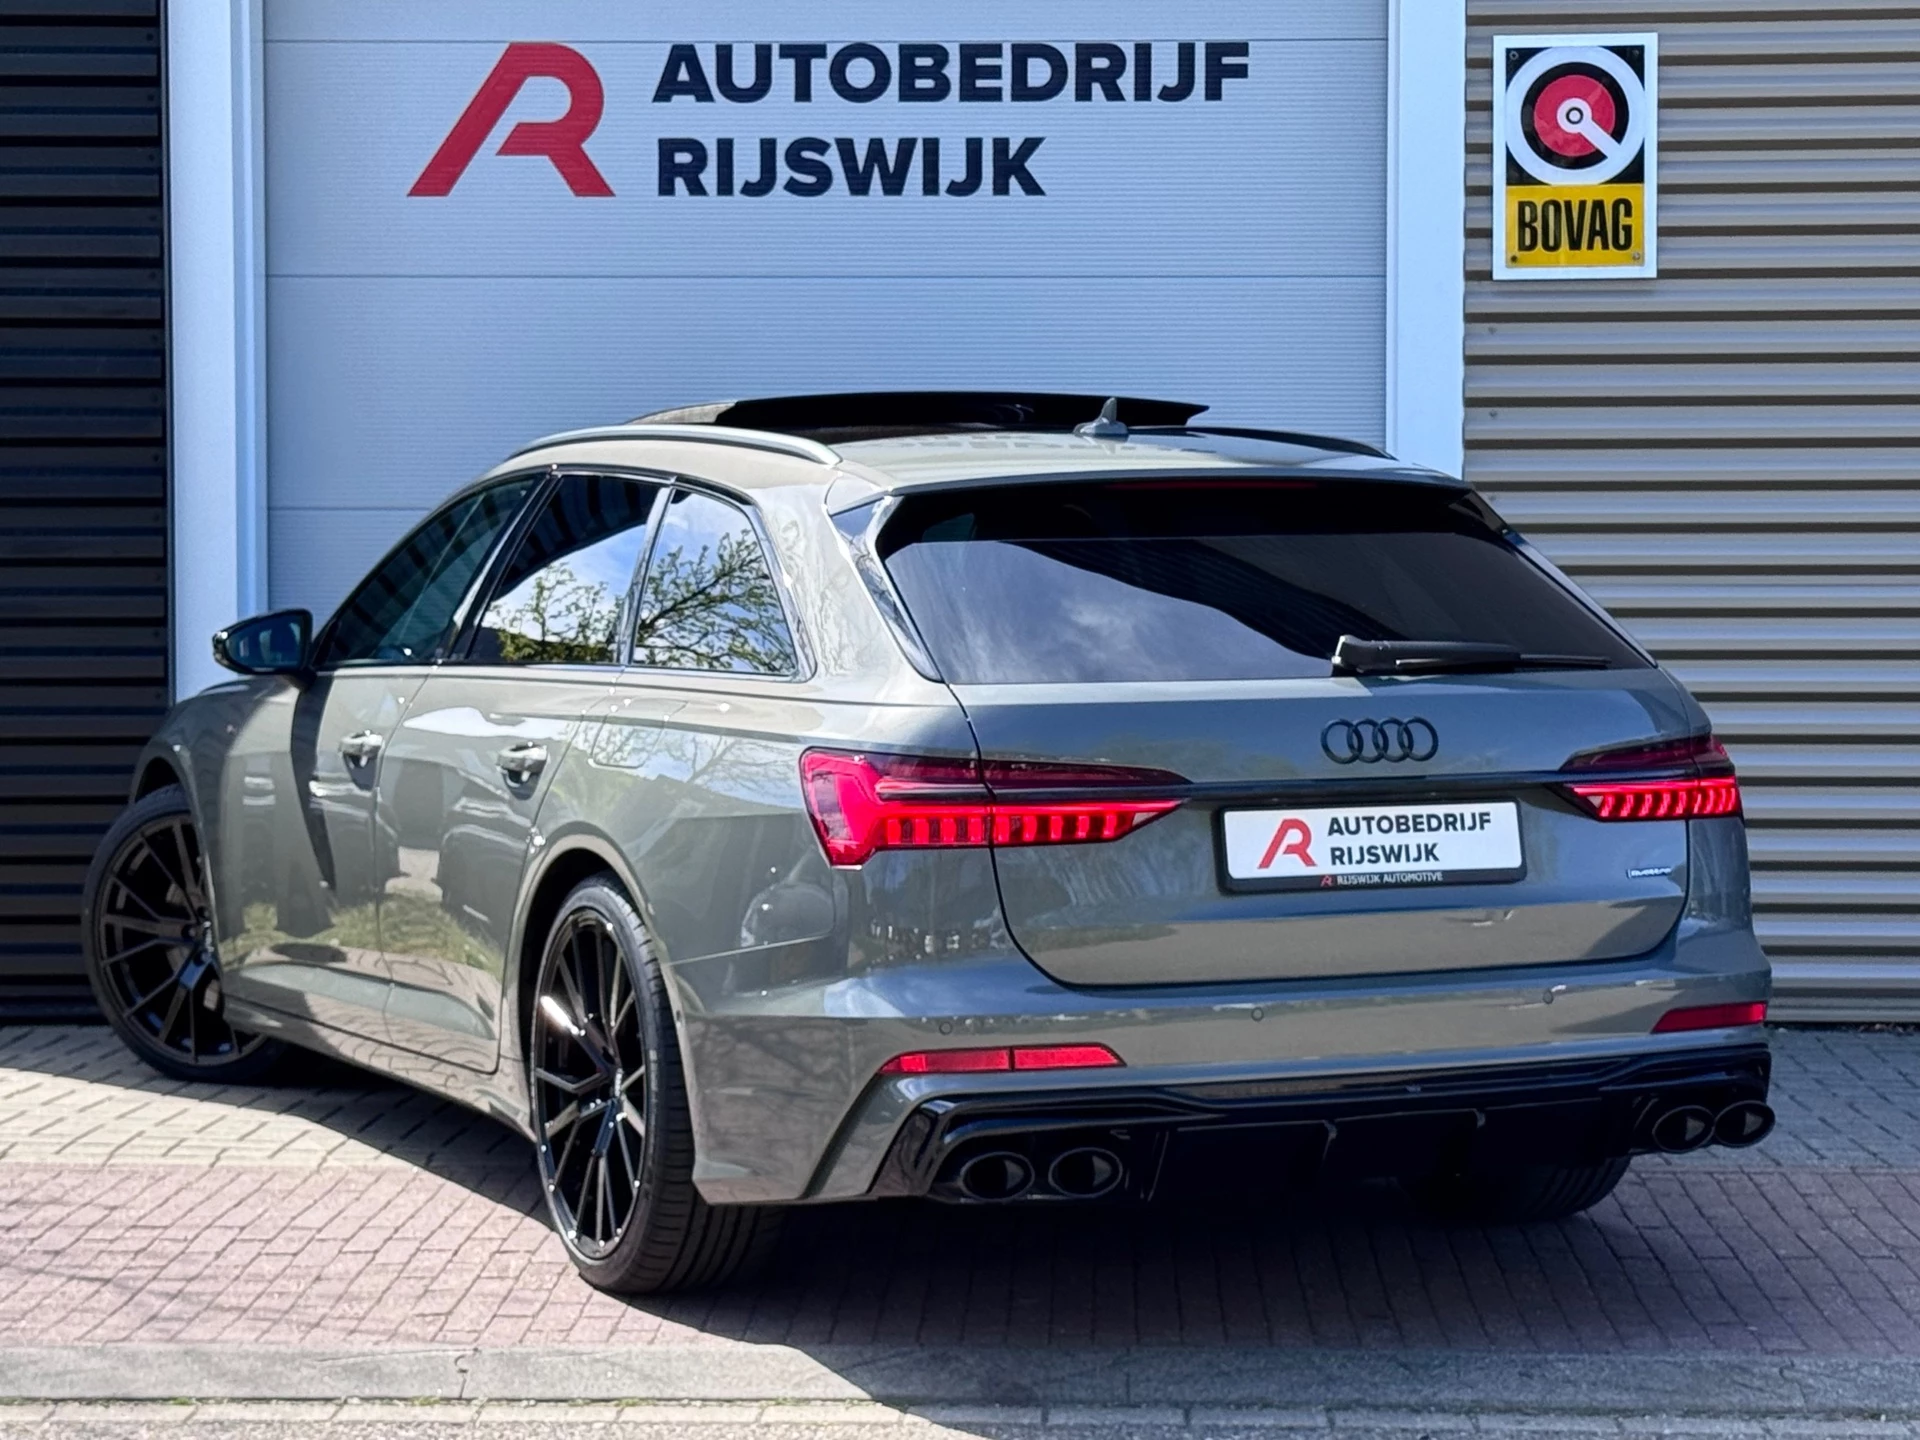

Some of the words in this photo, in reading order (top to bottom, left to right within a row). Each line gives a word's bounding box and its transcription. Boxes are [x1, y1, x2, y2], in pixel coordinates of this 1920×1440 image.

[652, 42, 1249, 103] AUTOBEDRIJF
[658, 137, 1046, 197] RIJSWIJK
[1517, 197, 1633, 252] BOVAG
[1327, 812, 1491, 836] AUTOBEDRIJF
[1330, 843, 1439, 866] RIJSWIJK
[1337, 874, 1380, 886] RIJSWIJK
[1383, 871, 1443, 884] AUTOMOTIVE
